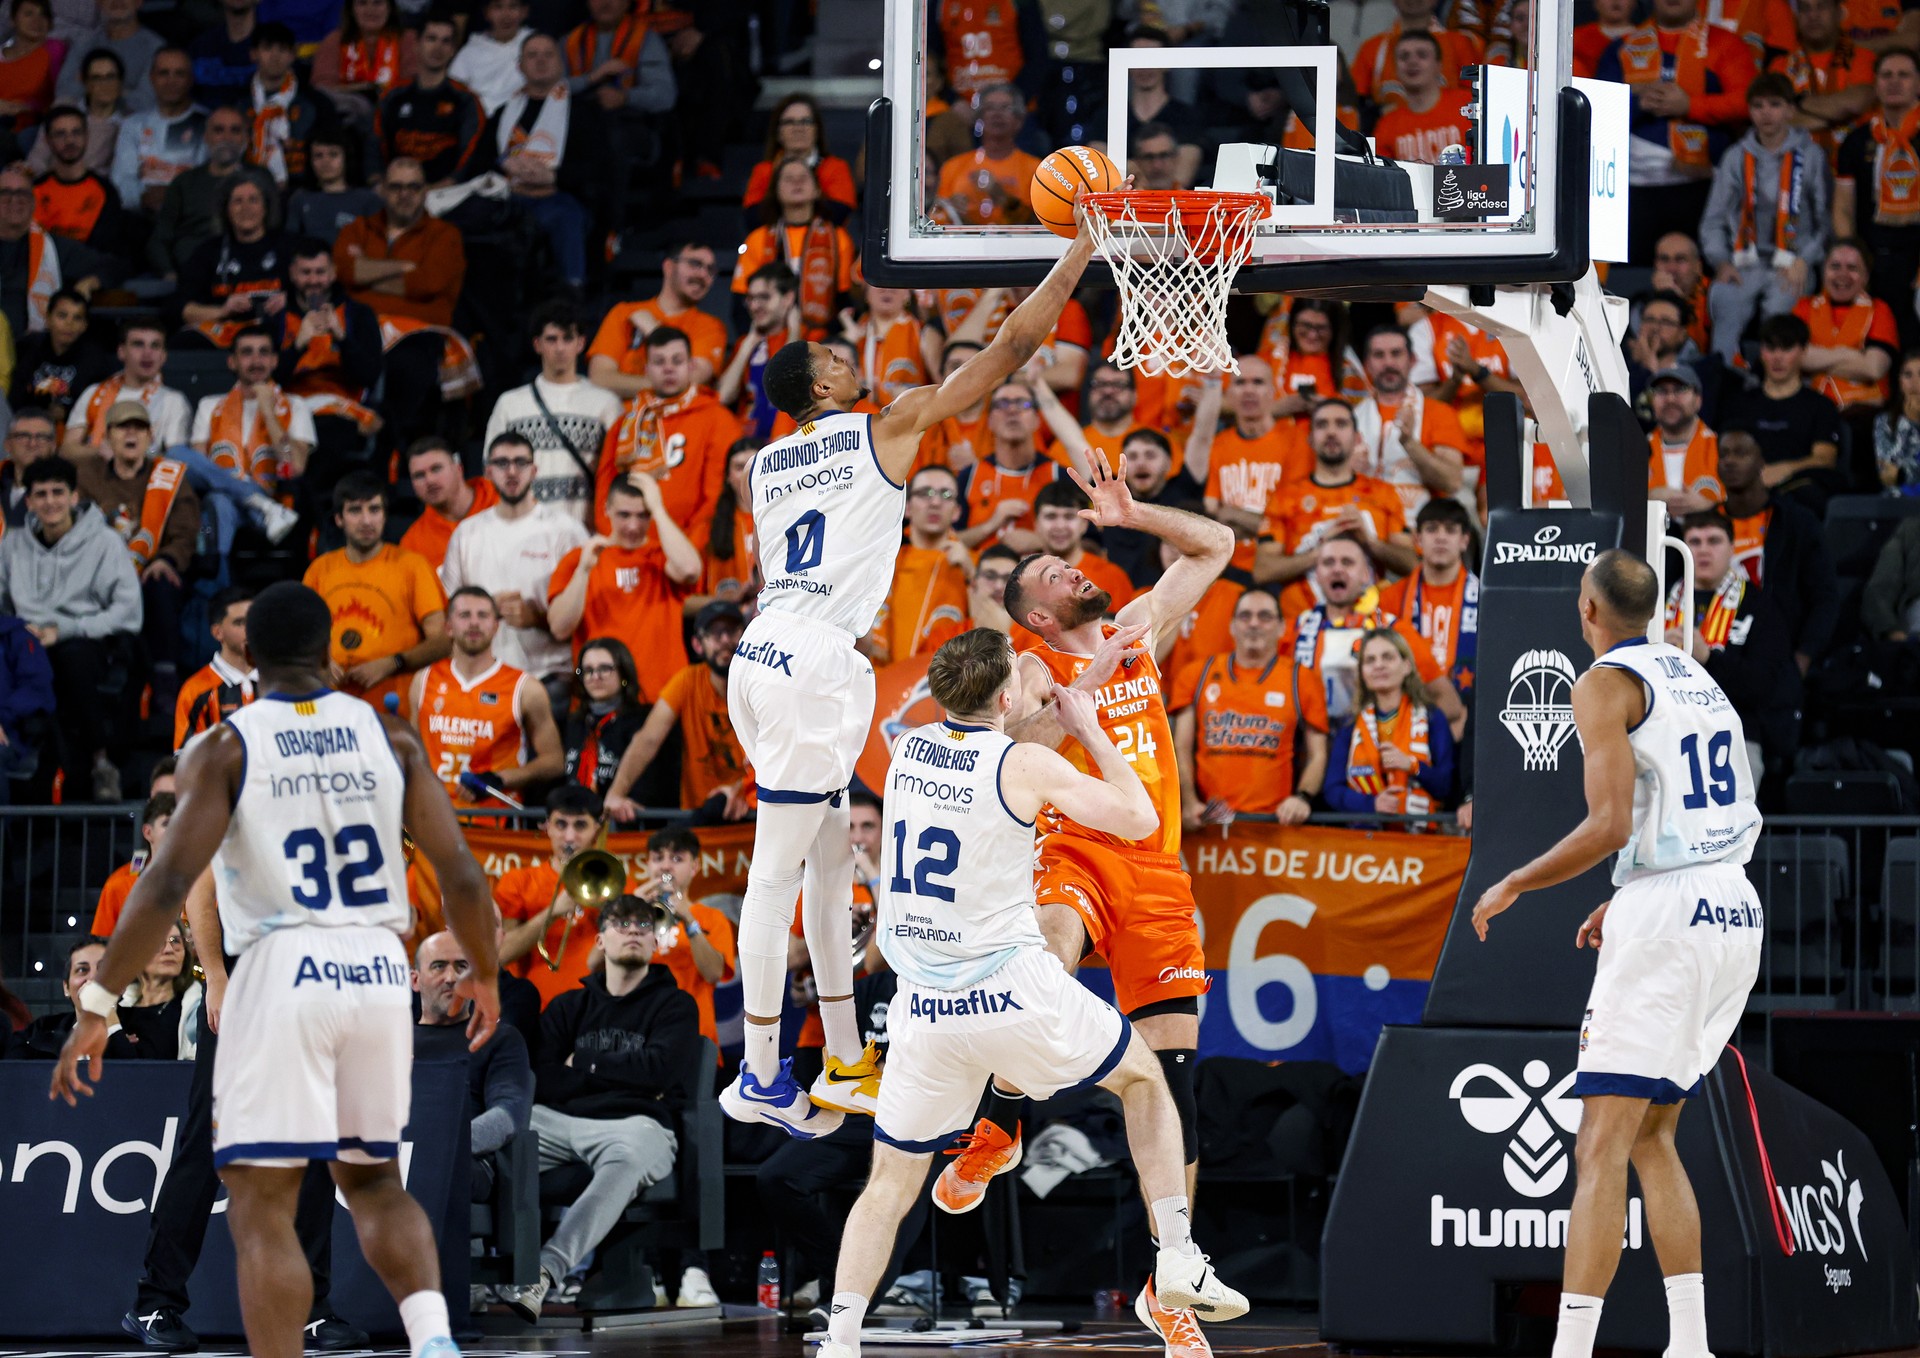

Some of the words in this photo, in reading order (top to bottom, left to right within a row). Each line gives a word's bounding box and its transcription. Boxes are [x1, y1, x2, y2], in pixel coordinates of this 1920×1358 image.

[1466, 189, 1486, 202] liga
[1466, 199, 1508, 210] endesa
[759, 430, 860, 477] AKOBUNDU-EHIOGU
[1494, 542, 1597, 565] SPALDING
[1094, 676, 1160, 711] ALENCIA
[1107, 699, 1149, 720] BASKET
[429, 715, 494, 741] VALENCIA
[1506, 712, 1546, 721] VALENCIA
[904, 736, 980, 773] STEINBERGS
[1112, 721, 1158, 763] 24
[1681, 730, 1736, 809] 19
[934, 803, 942, 811] by
[943, 804, 971, 815] AVINENT
[283, 823, 389, 910] 32
[890, 819, 961, 904] 12
[1197, 846, 1257, 876] HAS
[1263, 848, 1309, 880] DE
[1312, 853, 1425, 887] JUGAR
[1159, 966, 1206, 984] Midea
[911, 989, 1025, 1023] Aquaflix
[1430, 1194, 1643, 1250] humml
[1776, 1184, 1847, 1255] MGS
[1824, 1262, 1853, 1295] Seguros
